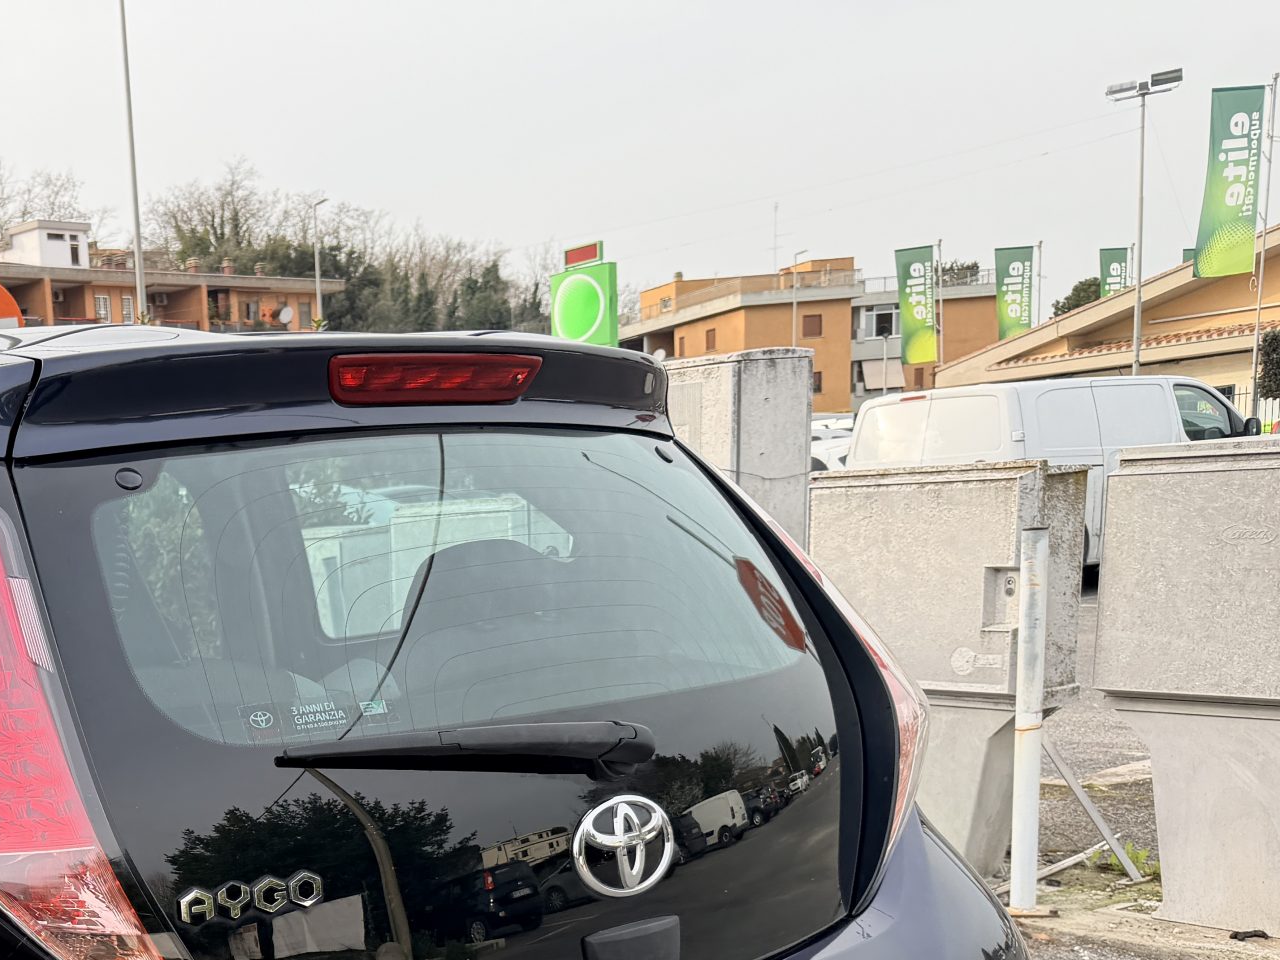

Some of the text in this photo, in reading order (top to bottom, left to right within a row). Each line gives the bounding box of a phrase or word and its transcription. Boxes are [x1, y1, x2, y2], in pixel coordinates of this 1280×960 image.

[290, 701, 336, 715] 3 ANNI DI
[294, 710, 346, 724] GARANZIA
[179, 872, 323, 924] AYGO
